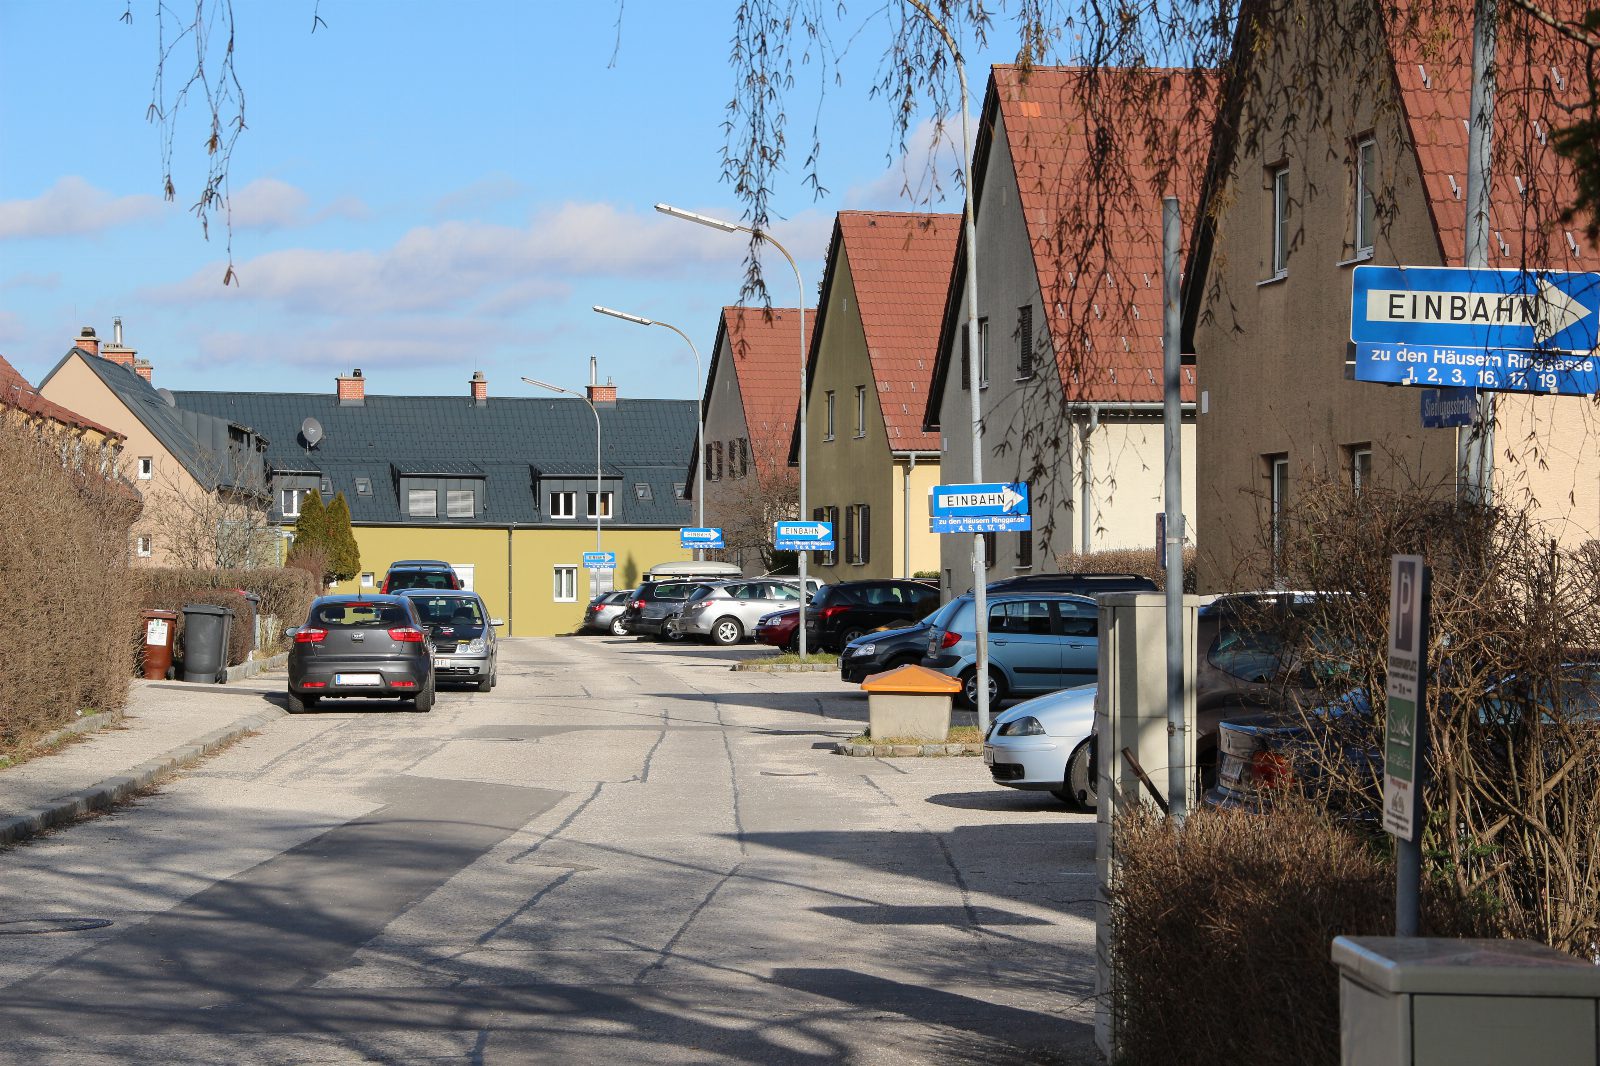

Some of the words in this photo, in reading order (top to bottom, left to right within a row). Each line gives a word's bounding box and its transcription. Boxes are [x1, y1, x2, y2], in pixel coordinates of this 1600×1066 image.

[1388, 293, 1540, 324] EINBAHN
[1371, 349, 1391, 361] zu
[1396, 348, 1428, 363] den
[1433, 349, 1501, 367] Häusern
[1507, 353, 1594, 373] Ringgasse
[1406, 366, 1419, 383] 1,
[1427, 367, 1443, 385] 2,
[1451, 368, 1467, 385] 3,
[1477, 370, 1500, 388] 16,
[1508, 372, 1528, 390] 17,
[1538, 373, 1557, 388] 19
[947, 494, 1005, 506] EINBAHN
[785, 527, 819, 535] EINBAHN
